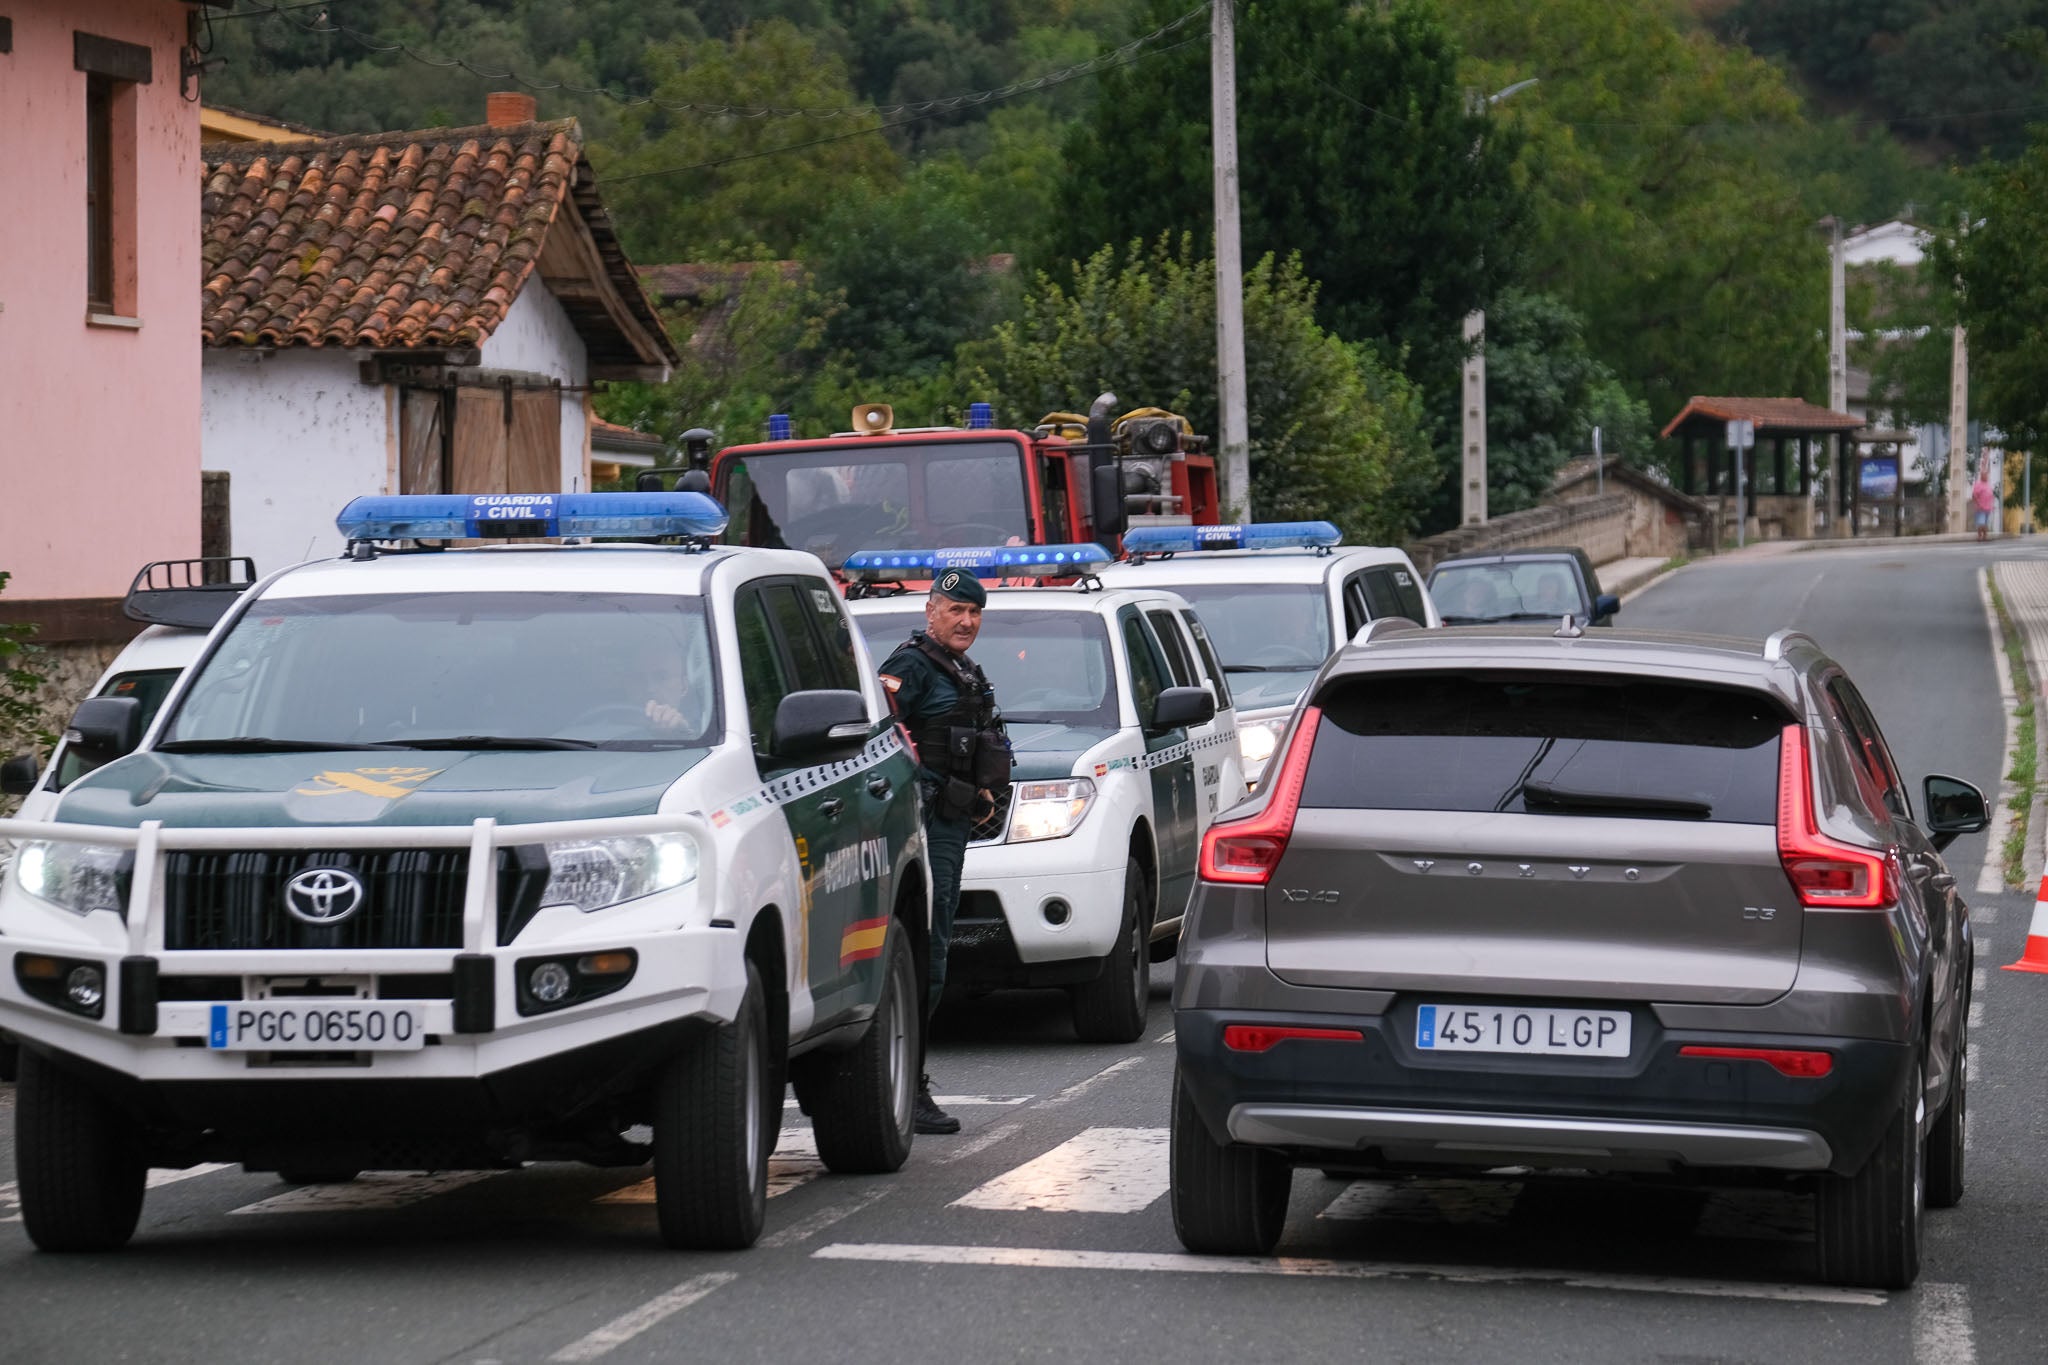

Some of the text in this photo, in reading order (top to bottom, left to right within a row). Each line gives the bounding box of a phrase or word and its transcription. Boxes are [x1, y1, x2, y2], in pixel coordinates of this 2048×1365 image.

[473, 495, 553, 506] GUARDIA
[488, 506, 536, 518] CIVIL
[1205, 532, 1233, 541] CIVIL
[936, 550, 992, 559] GUARDIA
[947, 558, 980, 568] CIVIL
[861, 836, 891, 881] CIVIL
[1413, 860, 1640, 881] VOLVO
[1743, 906, 1777, 920] D3
[237, 1010, 297, 1042] PGC
[1440, 1011, 1617, 1049] 4510 LGP
